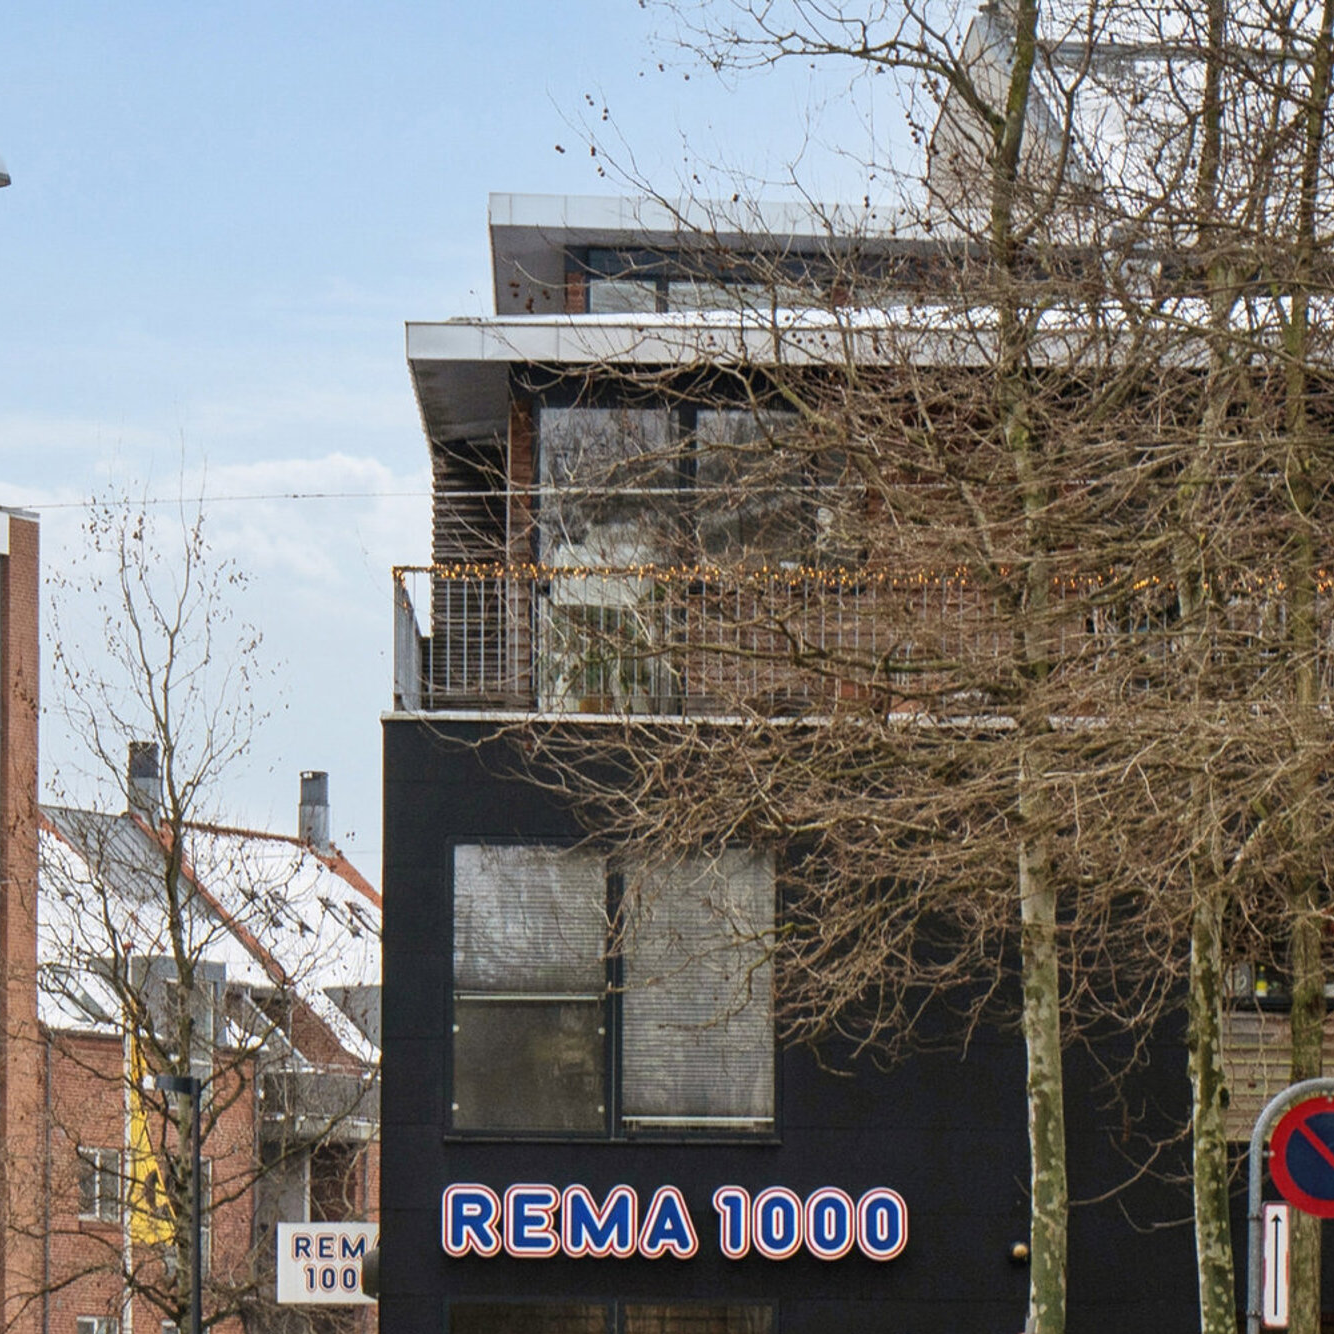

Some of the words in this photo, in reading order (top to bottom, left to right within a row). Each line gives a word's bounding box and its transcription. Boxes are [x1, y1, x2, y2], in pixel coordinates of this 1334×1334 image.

[442, 1183, 698, 1258] REMA
[713, 1185, 907, 1260] 1000
[291, 1232, 379, 1262] REM
[303, 1263, 362, 1293] 100
